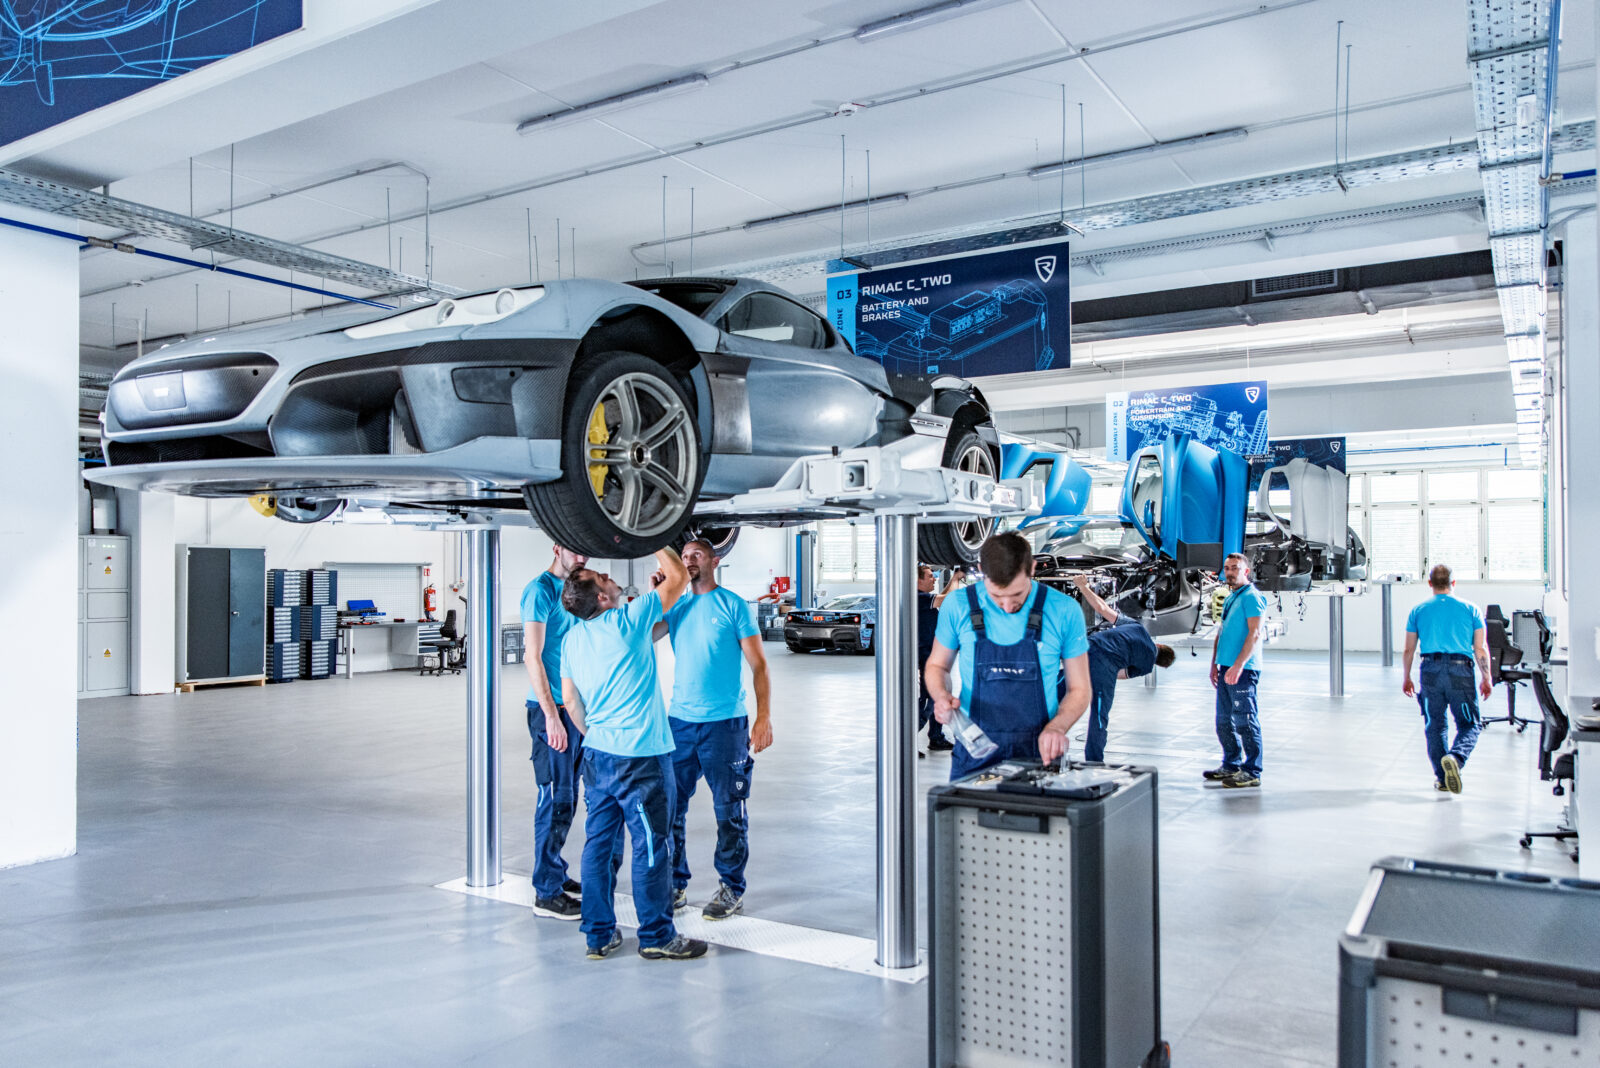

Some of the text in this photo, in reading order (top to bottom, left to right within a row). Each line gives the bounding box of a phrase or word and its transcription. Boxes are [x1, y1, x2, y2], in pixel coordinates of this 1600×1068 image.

[861, 274, 952, 297] RIMAC C_TWO
[837, 289, 852, 300] 03
[861, 296, 929, 313] BATTERY AND
[836, 307, 844, 331] ZONE
[861, 310, 901, 323] BRAKES
[1130, 394, 1192, 406] RIMAC C_TWO
[1130, 406, 1175, 415] POWERTRAIN
[1130, 413, 1175, 421] SUSPENSION
